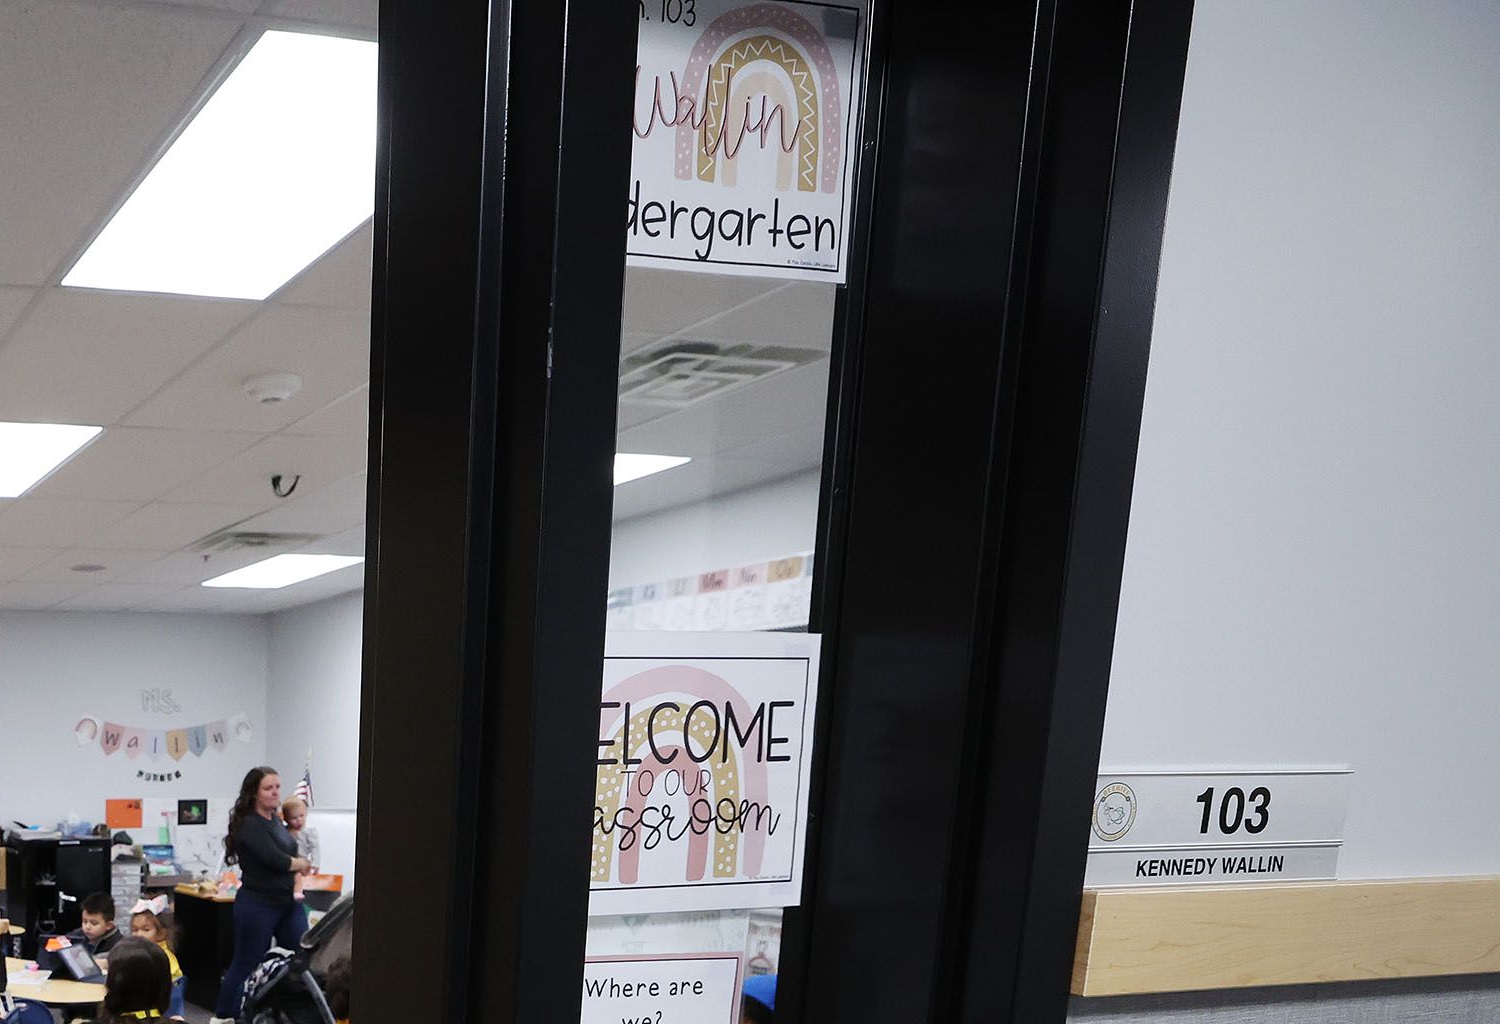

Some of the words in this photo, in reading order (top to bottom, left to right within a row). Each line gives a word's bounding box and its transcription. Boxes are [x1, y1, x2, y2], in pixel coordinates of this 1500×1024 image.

[661, 0, 696, 27] 103
[627, 180, 835, 260] dergarten
[621, 769, 654, 797] TO
[664, 769, 712, 797] OUR
[1196, 786, 1271, 835] 103
[1135, 856, 1218, 877] KENNEDY
[1221, 855, 1284, 874] WALLIN
[585, 977, 660, 998] Where
[669, 978, 704, 997] are
